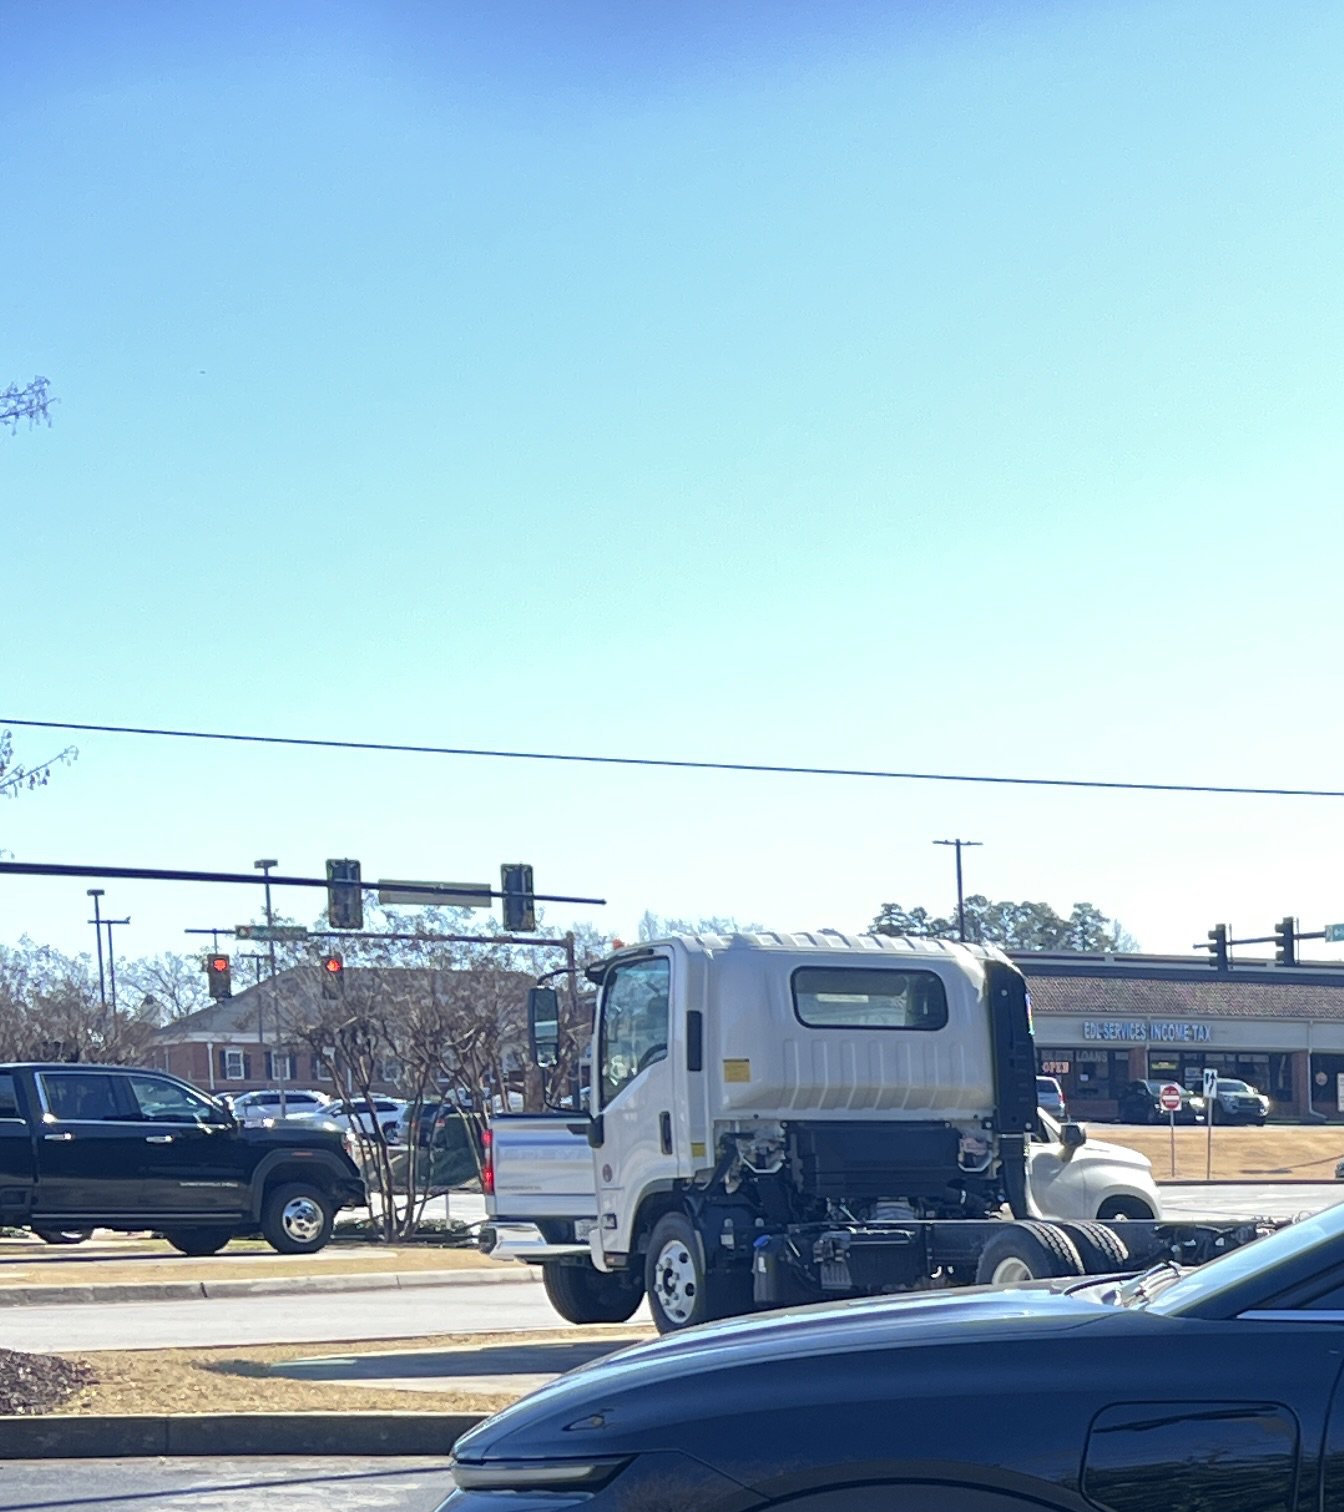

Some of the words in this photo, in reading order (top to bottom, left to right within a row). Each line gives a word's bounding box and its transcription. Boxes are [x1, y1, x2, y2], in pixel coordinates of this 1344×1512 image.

[1150, 1023, 1189, 1041] INCOME
[1193, 1024, 1212, 1041] TAX
[1042, 1062, 1069, 1073] OPEN
